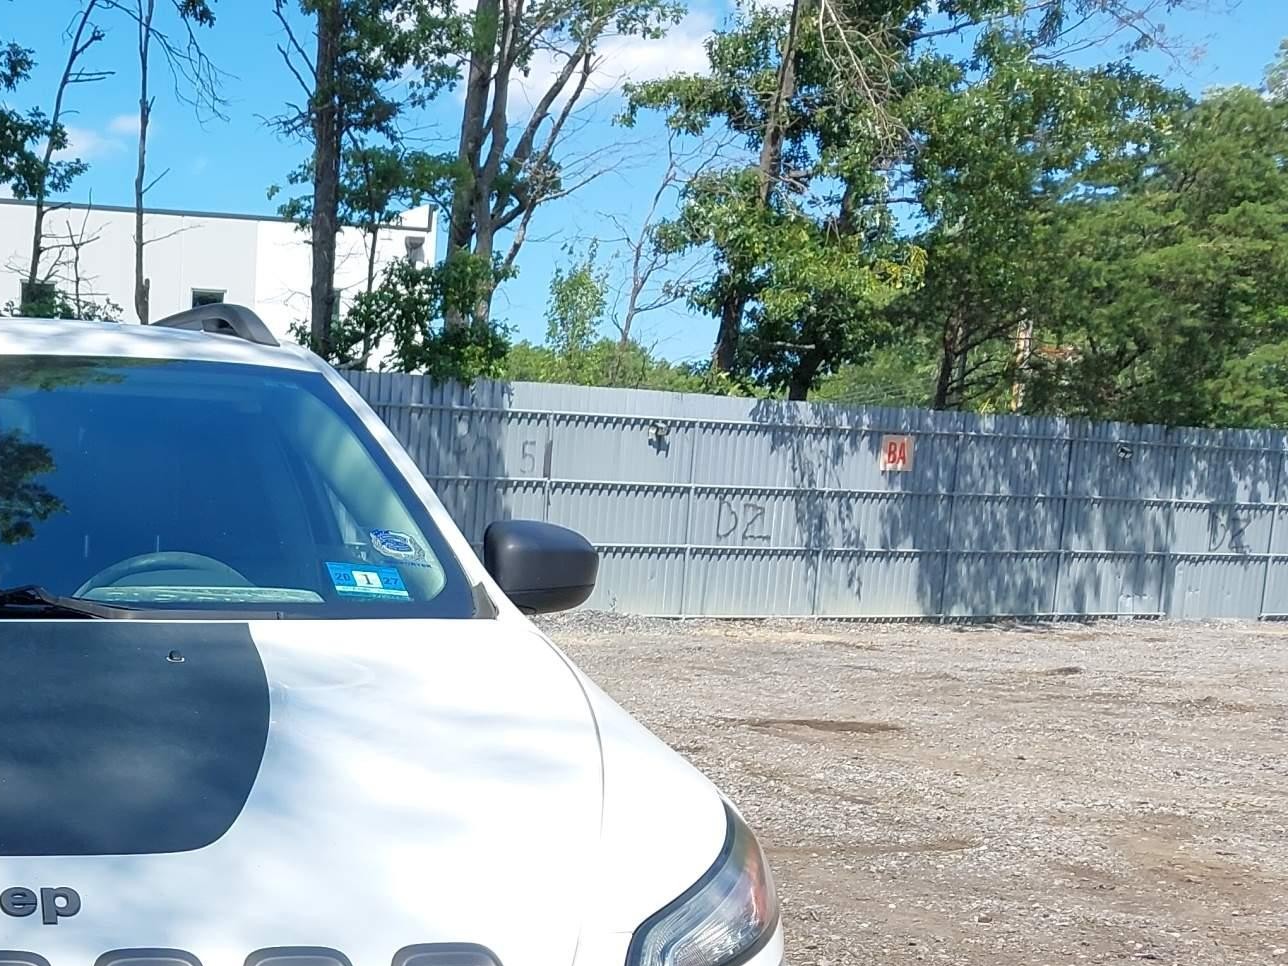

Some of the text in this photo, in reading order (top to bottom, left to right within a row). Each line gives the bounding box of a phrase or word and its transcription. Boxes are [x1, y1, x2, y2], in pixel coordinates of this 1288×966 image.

[887, 441, 906, 465] BA
[334, 572, 351, 582] 20
[382, 576, 399, 586] 27
